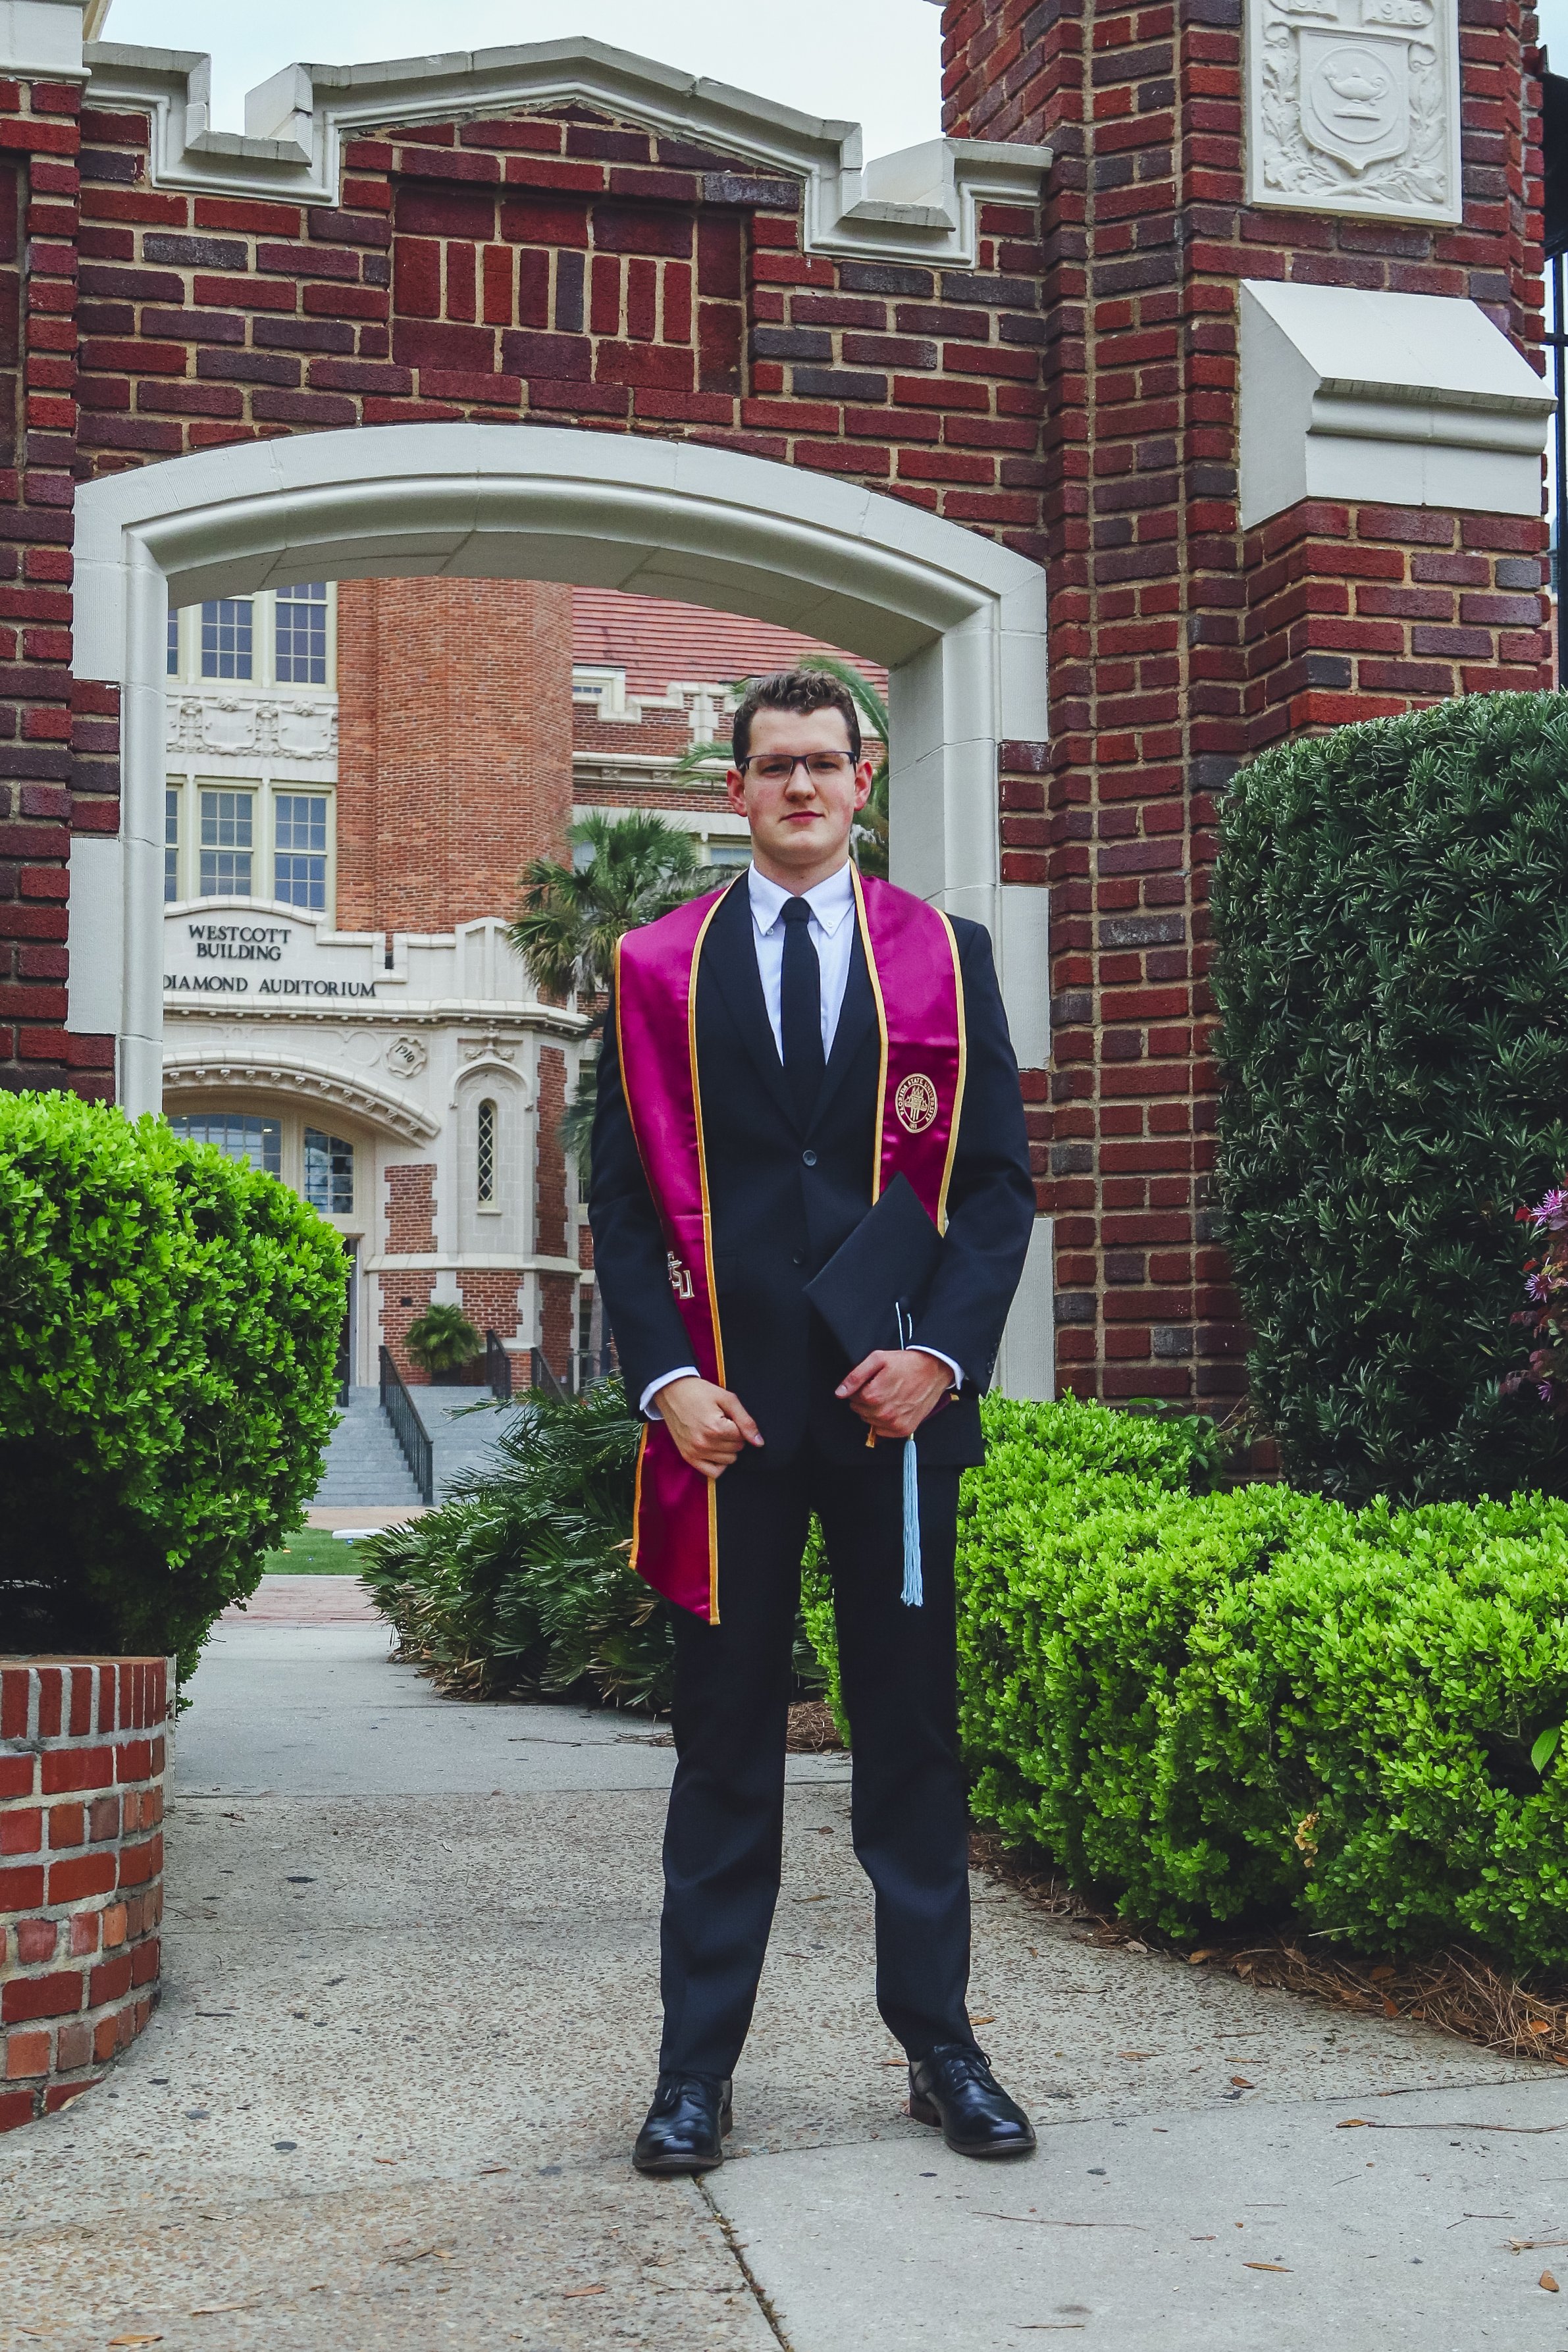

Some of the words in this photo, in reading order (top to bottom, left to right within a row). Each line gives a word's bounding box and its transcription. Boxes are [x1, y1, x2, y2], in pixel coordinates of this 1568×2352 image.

[188, 924, 292, 943] WESTCOTT
[196, 942, 281, 961] BUILDING
[163, 974, 248, 991] DIAMOND
[259, 979, 376, 997] AUDITORIUM
[395, 1045, 415, 1063] 1910
[898, 1085, 908, 1116] FLORIDA
[924, 1082, 935, 1122] UNIVERSITY
